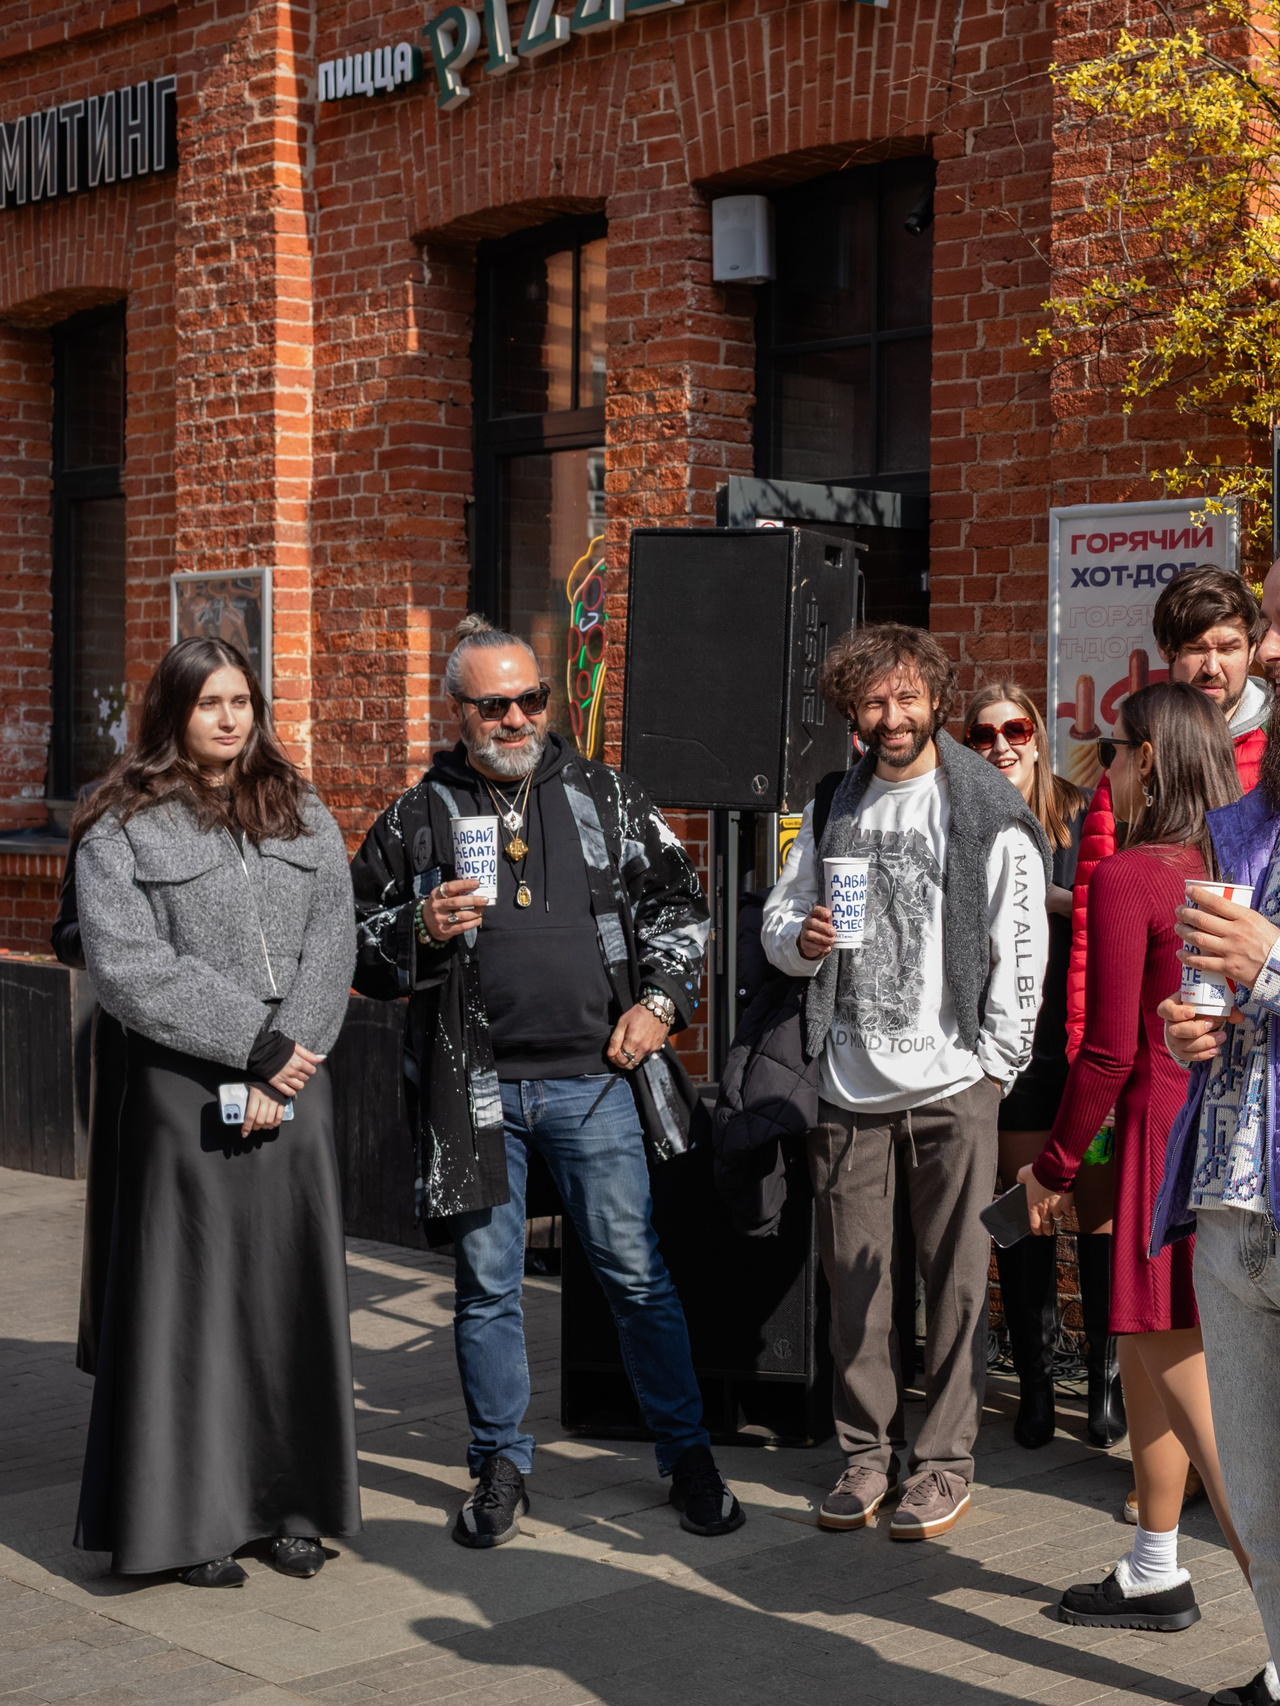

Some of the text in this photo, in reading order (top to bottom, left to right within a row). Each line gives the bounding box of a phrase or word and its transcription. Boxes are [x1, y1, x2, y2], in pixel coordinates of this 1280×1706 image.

[0, 74, 177, 209] МИТИНГ
[1071, 522, 1213, 555] ГОРЯЧИЙ
[830, 874, 867, 889] ДАВА
[1012, 854, 1030, 912] MAY
[832, 918, 865, 930] ВМЕС
[1013, 919, 1033, 968] ALL
[1017, 975, 1037, 1010] BE
[888, 1035, 936, 1054] TOUR
